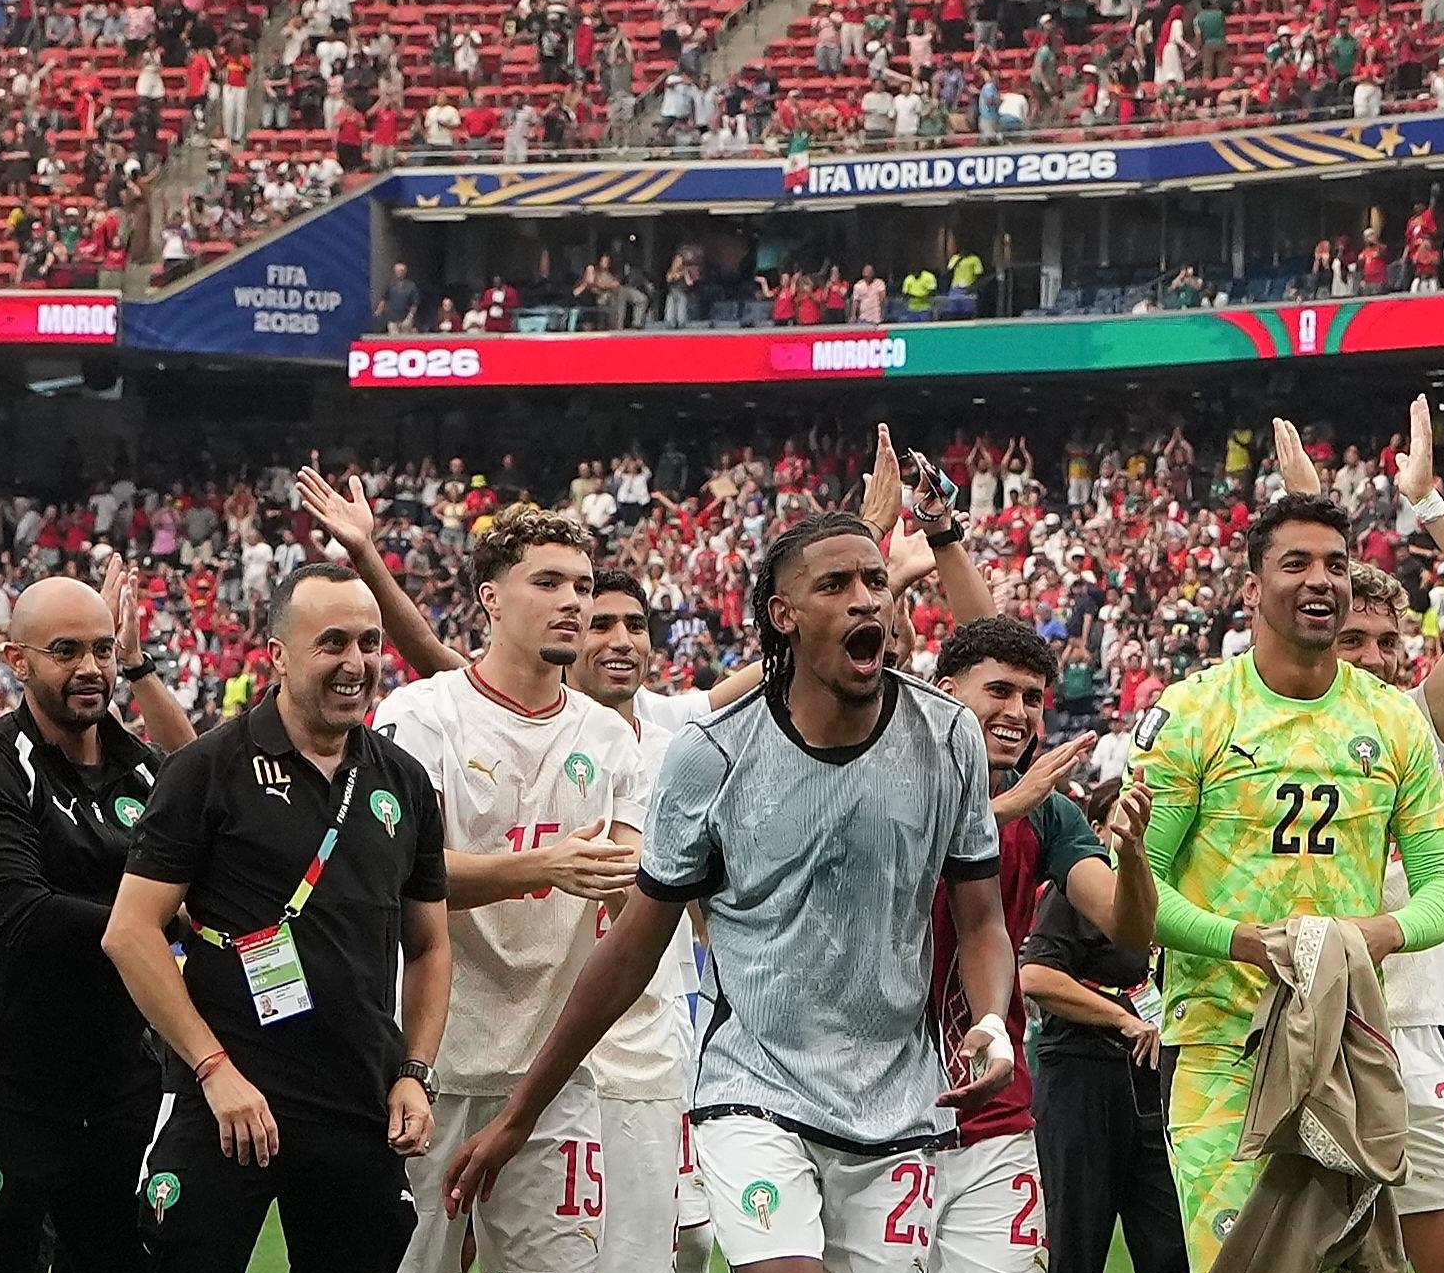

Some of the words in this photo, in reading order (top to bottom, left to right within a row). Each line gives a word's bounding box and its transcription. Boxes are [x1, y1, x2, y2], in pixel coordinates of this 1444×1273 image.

[793, 166, 852, 194] IFA
[855, 159, 955, 191] WORLD
[956, 155, 1015, 186] CUP
[1017, 150, 1117, 183] 2026
[266, 264, 308, 288] FIFA
[234, 285, 302, 309] WORLD
[303, 289, 343, 312] CUP
[253, 311, 320, 335] 2026
[372, 348, 480, 379] 2026
[812, 338, 906, 371] MOROCCO
[1271, 783, 1341, 855] 22
[556, 1139, 604, 1218] 15
[1010, 1172, 1039, 1247] 2
